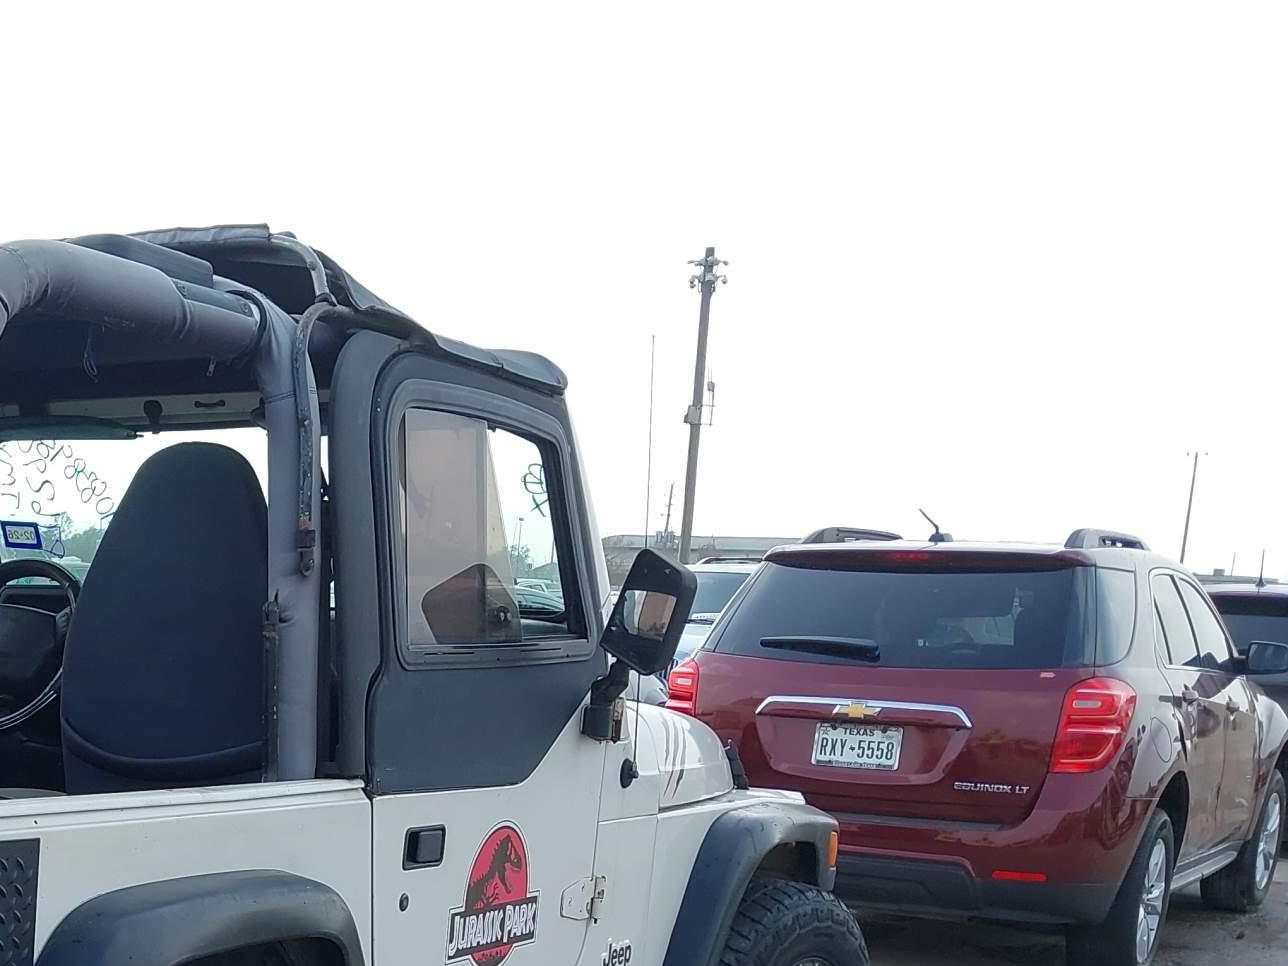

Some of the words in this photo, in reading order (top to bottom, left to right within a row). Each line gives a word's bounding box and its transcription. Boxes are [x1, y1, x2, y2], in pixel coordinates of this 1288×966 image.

[842, 727, 875, 737] TEXAS
[856, 740, 896, 761] 5558
[953, 781, 1012, 793] EQUINOX
[1015, 785, 1030, 794] LT
[503, 903, 537, 944] PARK
